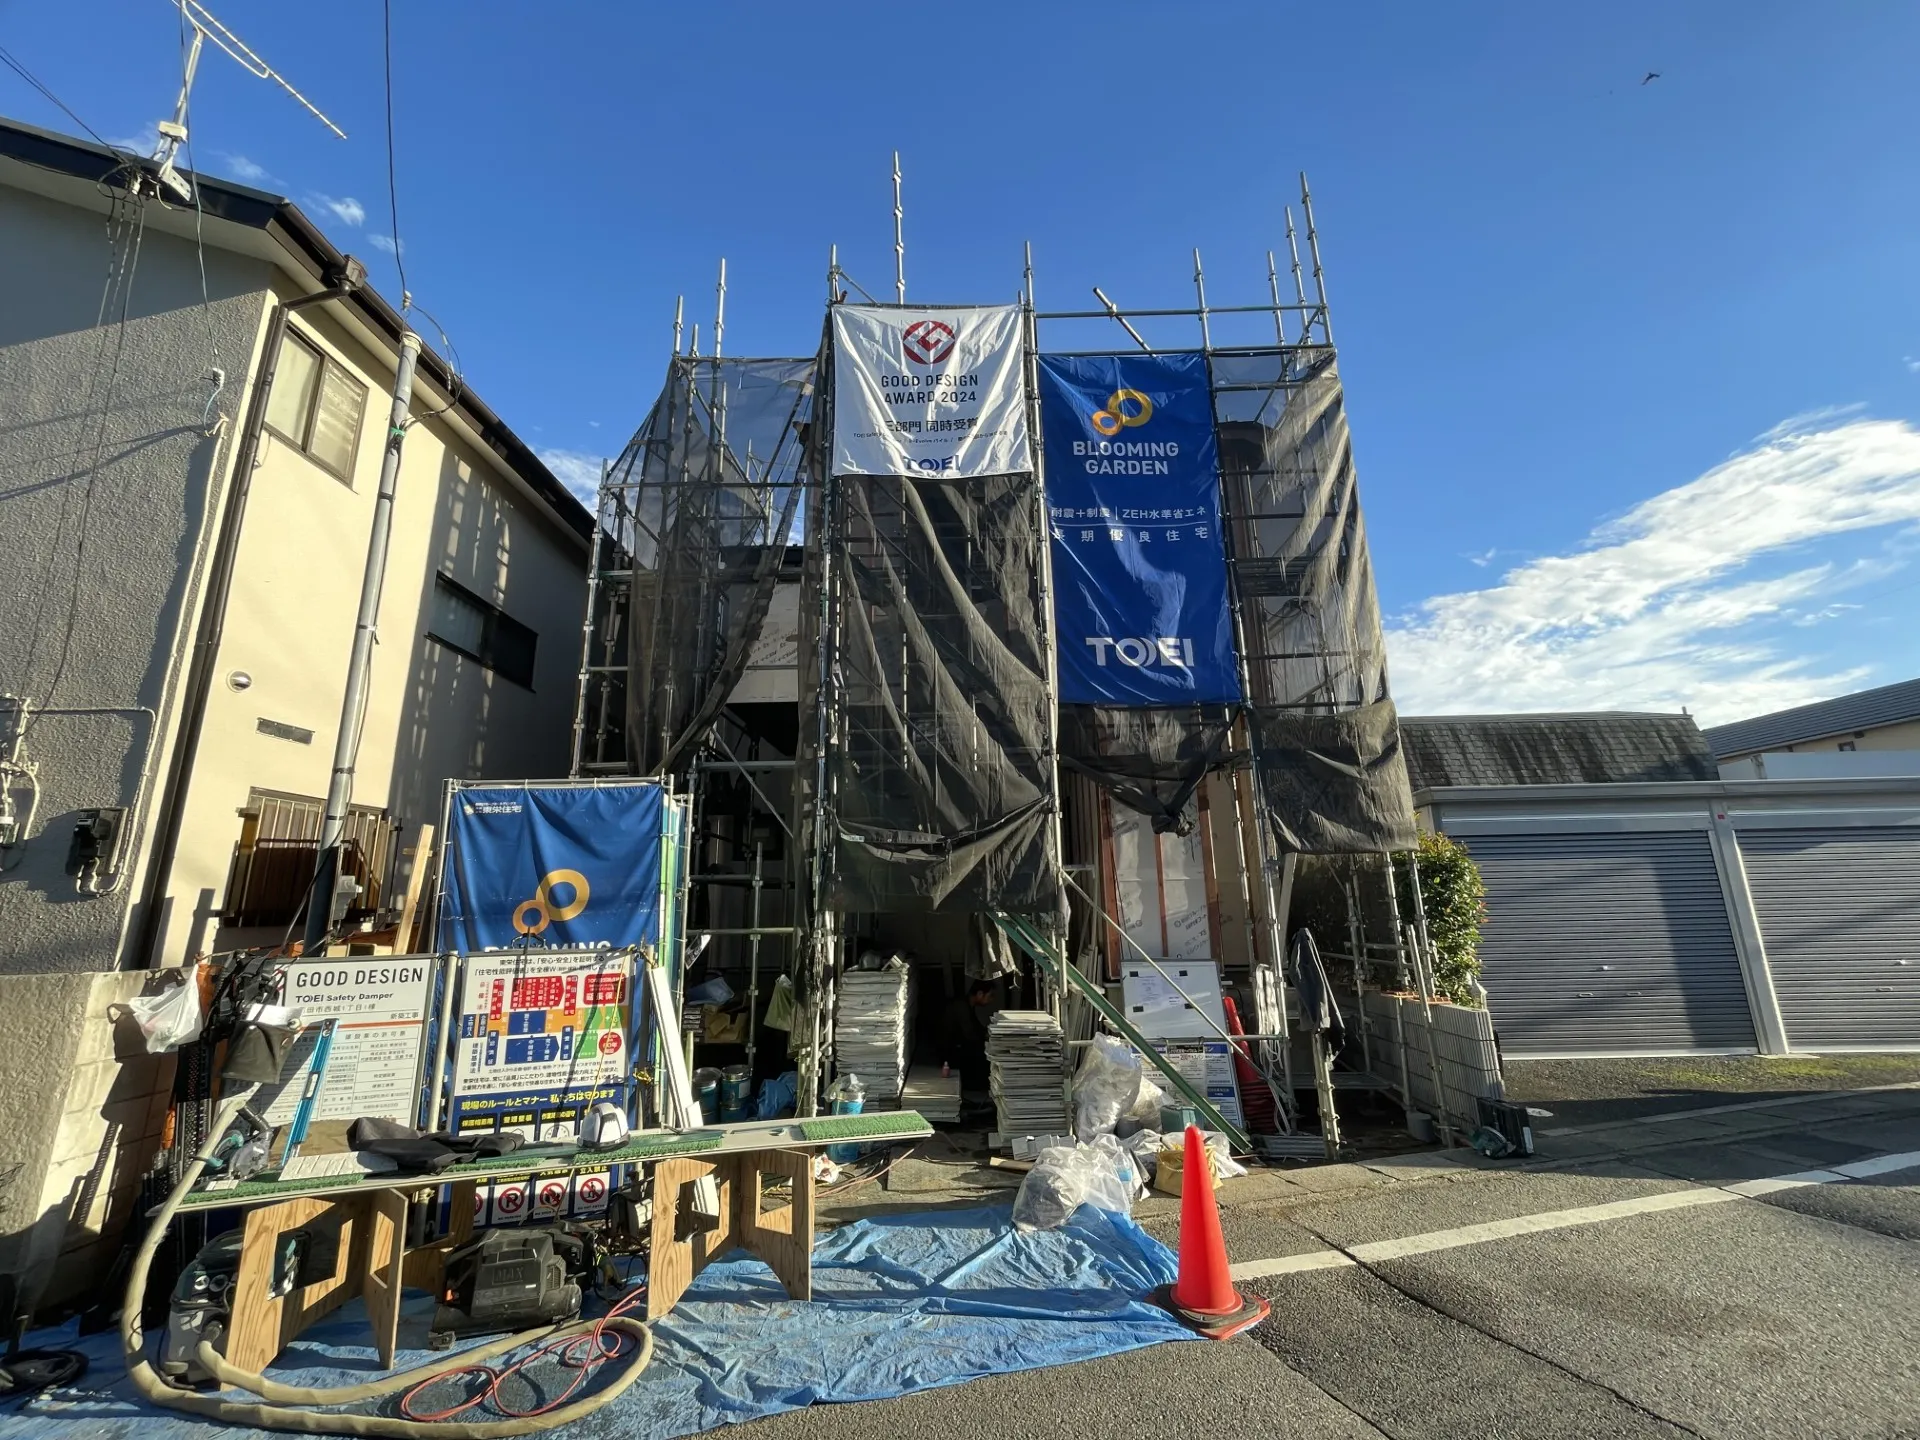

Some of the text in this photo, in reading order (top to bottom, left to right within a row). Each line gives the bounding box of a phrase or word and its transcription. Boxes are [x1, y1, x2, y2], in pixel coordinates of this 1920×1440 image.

[881, 374, 978, 388] GOOD DESIGN
[884, 391, 977, 405] AWARD 2024
[885, 417, 979, 433] 三部門 同時受賞
[1072, 440, 1179, 457] BLOOMING
[1085, 459, 1169, 475] GARDEN
[1085, 637, 1195, 667] TOEI
[296, 967, 423, 988] GOOD DESIGN
[296, 992, 394, 1003] TOEI Safety Damper
[461, 1096, 548, 1110] 現場のルールとマナー
[580, 1165, 608, 1175] 立入禁止
